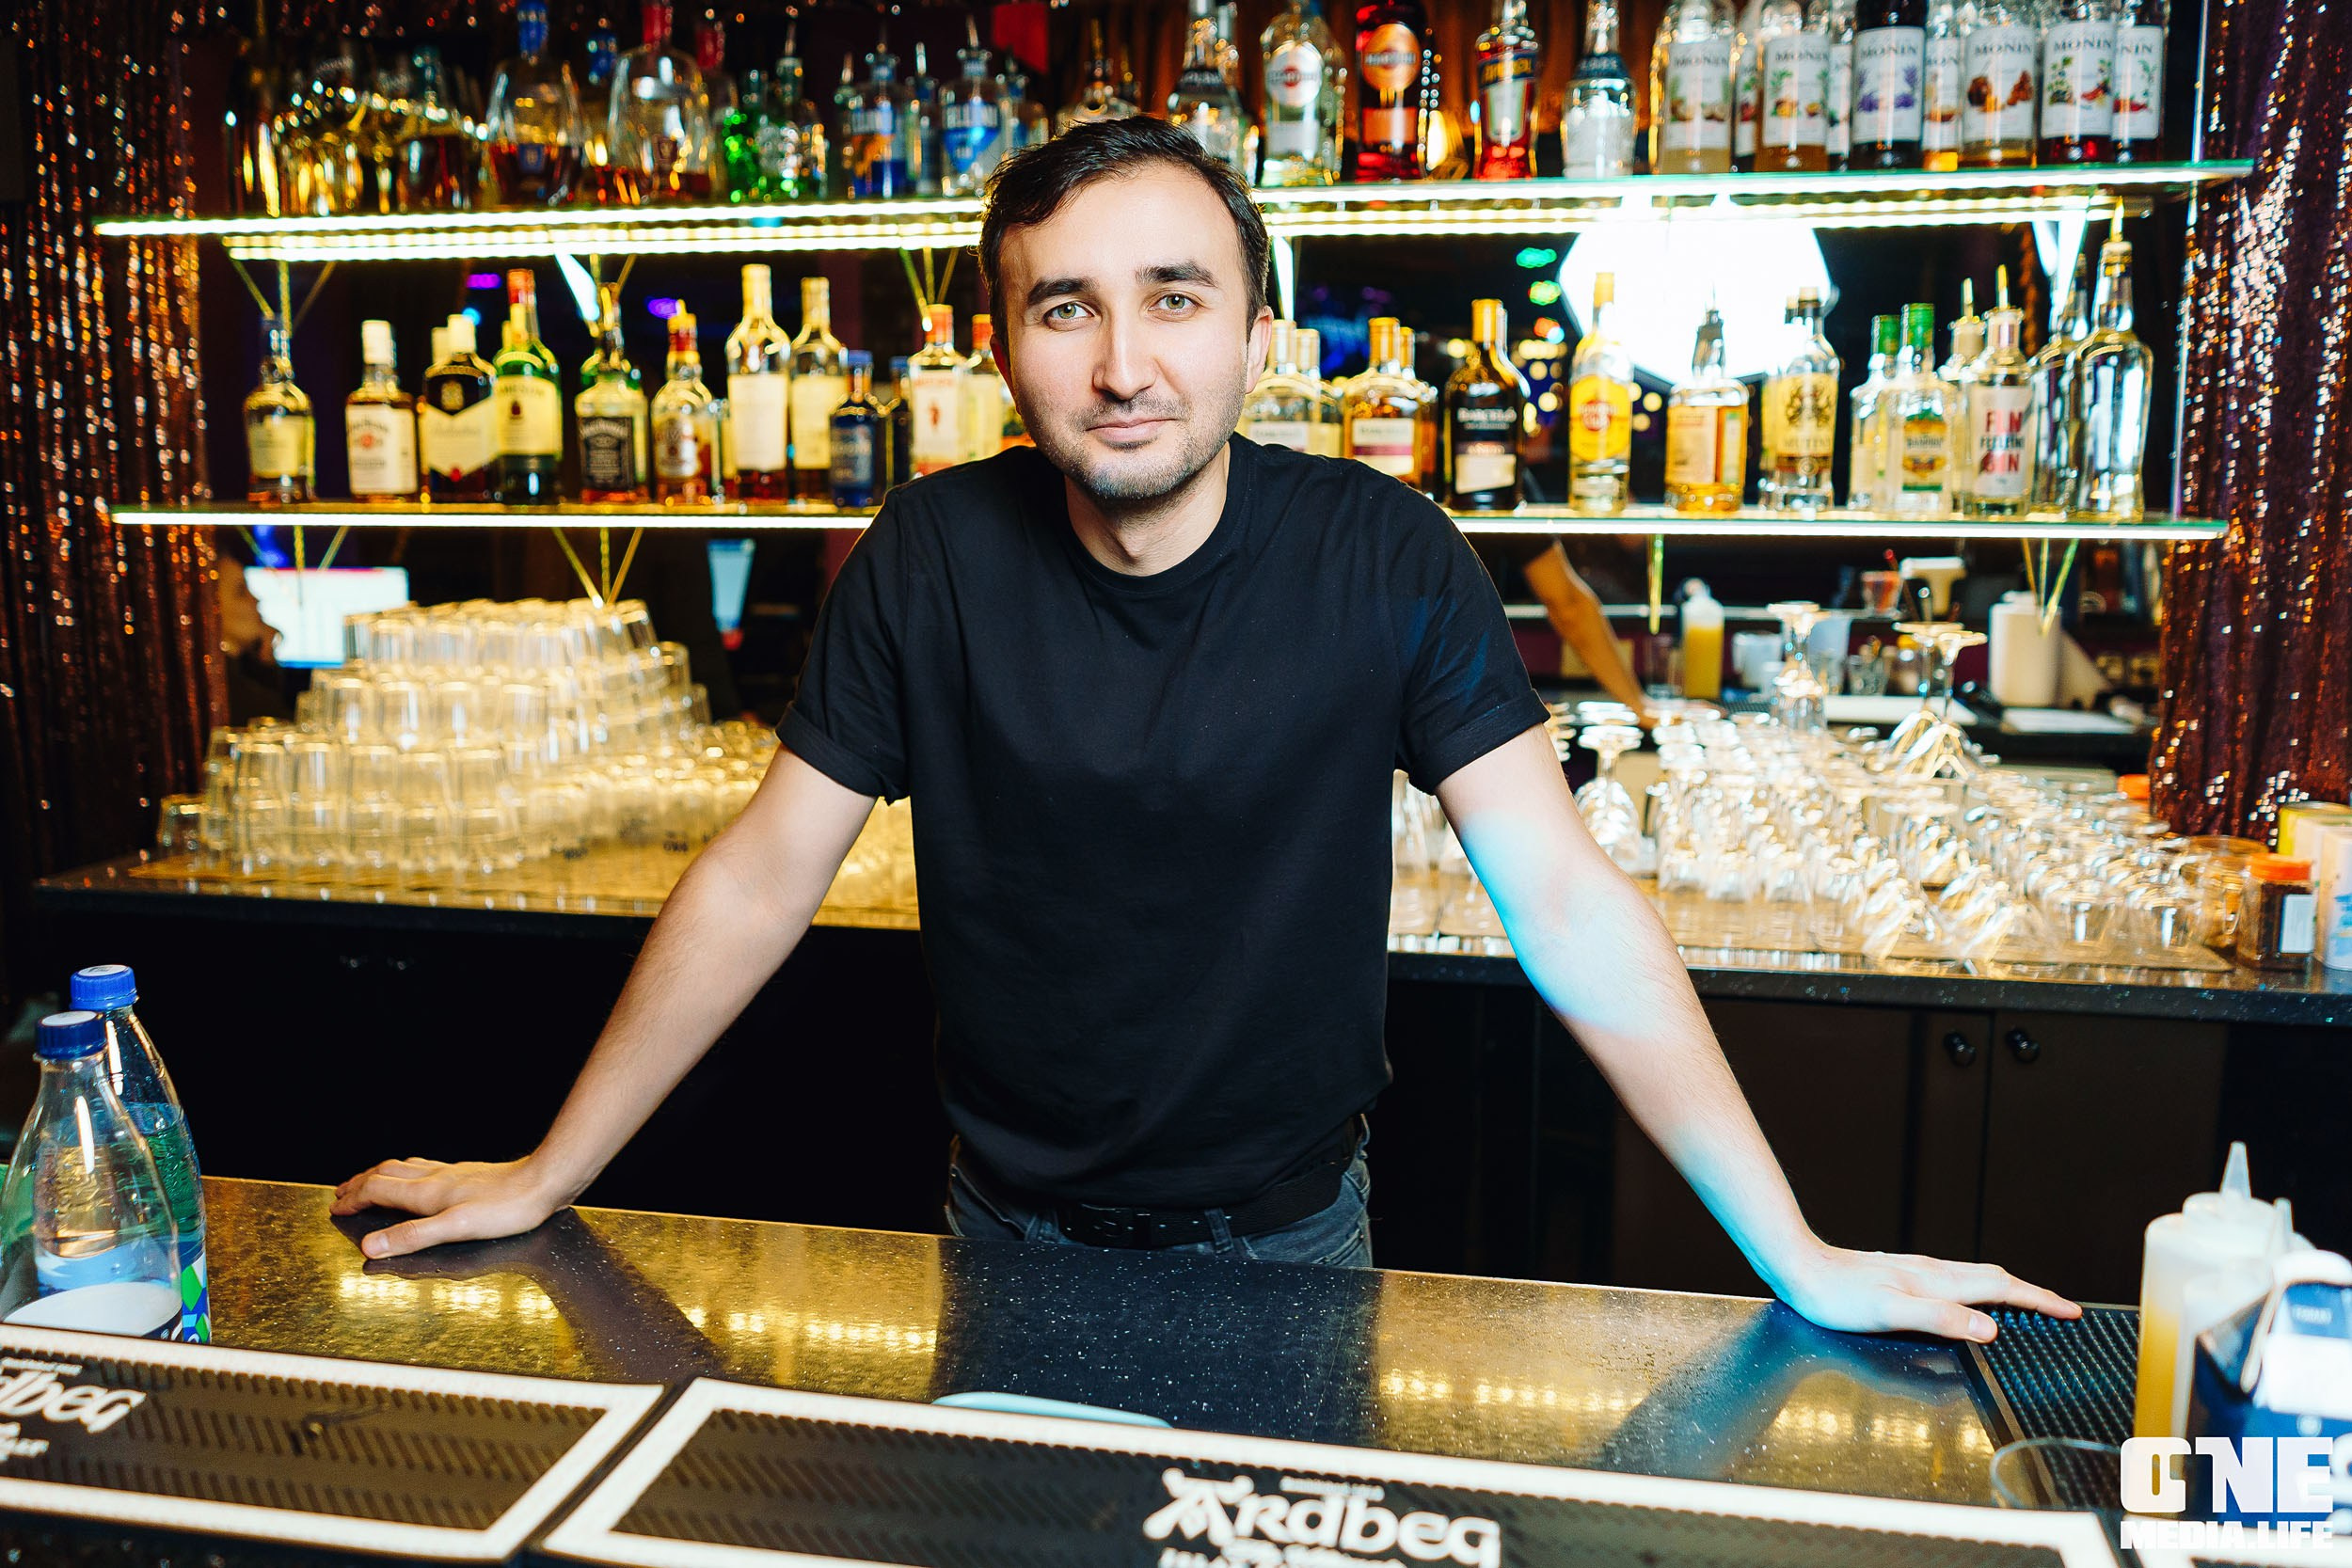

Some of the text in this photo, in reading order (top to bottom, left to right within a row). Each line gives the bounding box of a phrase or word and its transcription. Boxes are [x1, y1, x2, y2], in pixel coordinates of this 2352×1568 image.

[1975, 43, 2032, 55] MONIN
[2054, 35, 2112, 51] MONIN
[2120, 43, 2153, 55] NIN
[1774, 50, 1829, 62] MONIN
[1861, 44, 1917, 59] MONIN
[1676, 55, 1729, 69] MONIN
[1481, 56, 1533, 84] APEOL
